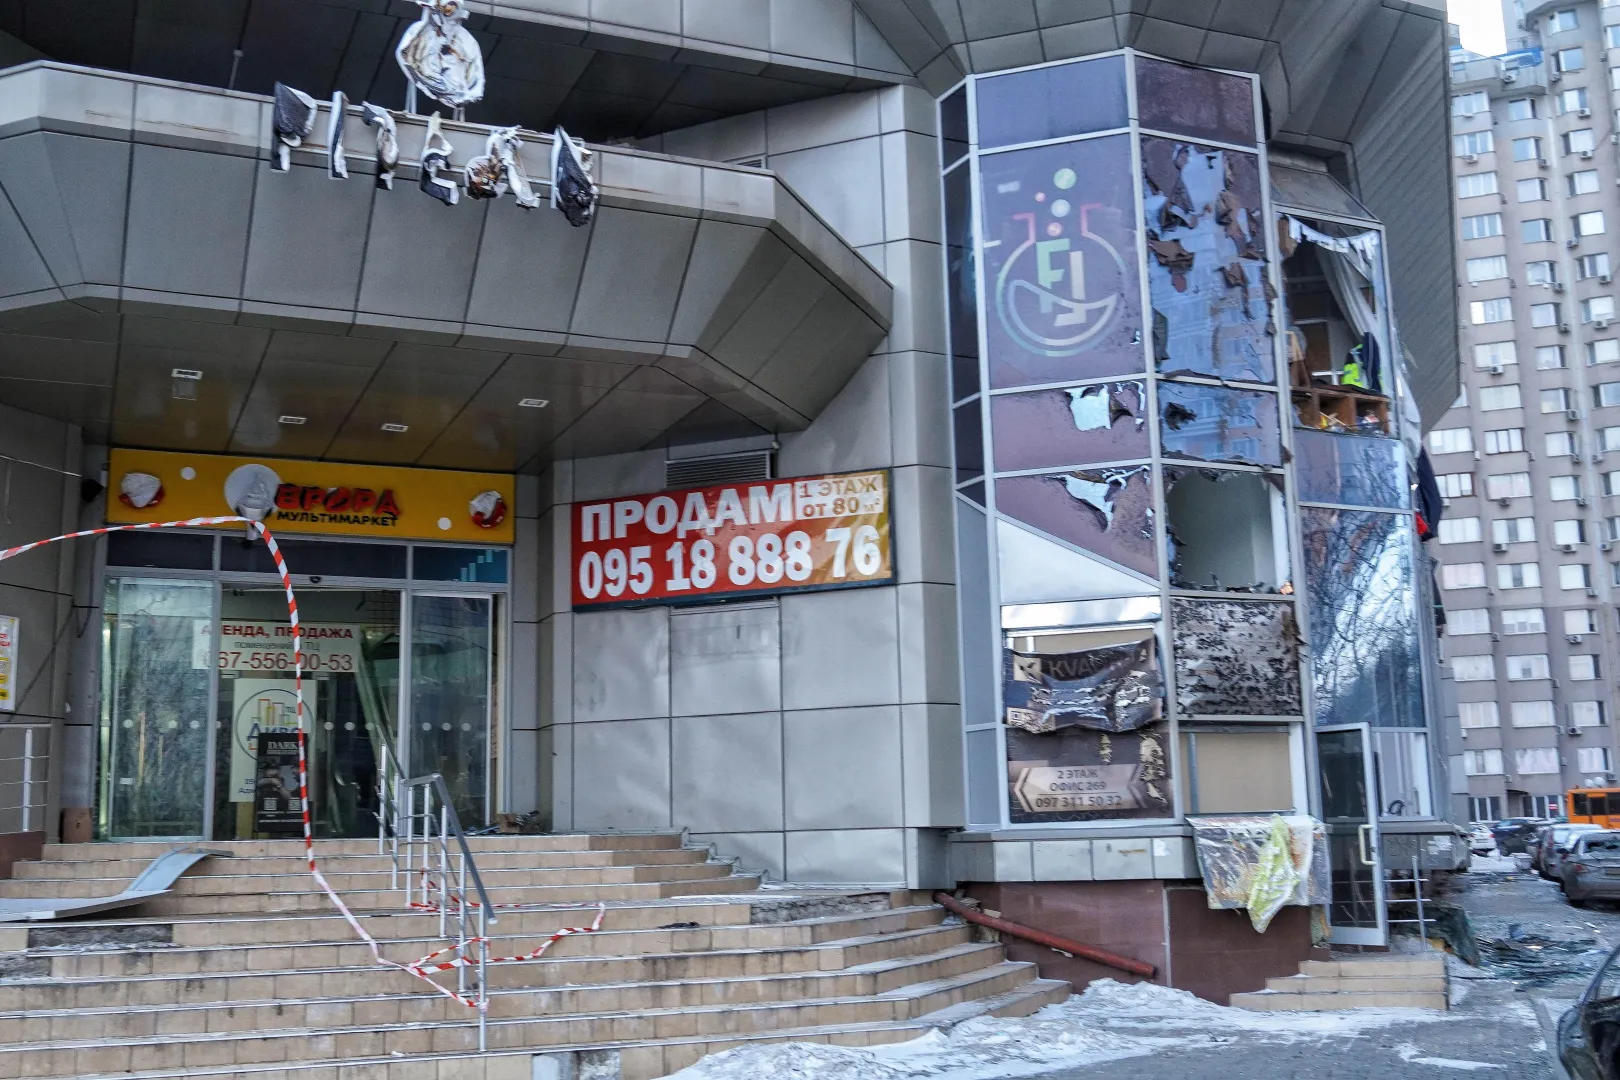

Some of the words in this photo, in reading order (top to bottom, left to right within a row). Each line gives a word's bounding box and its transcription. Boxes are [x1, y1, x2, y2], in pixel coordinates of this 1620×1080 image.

[799, 482, 813, 498] 1
[818, 476, 878, 496] ЭТАЖ
[581, 484, 793, 542] ПРОДАМ
[832, 497, 859, 515] 80
[277, 511, 398, 526] МУЛЬТИМАРКЕТ
[579, 545, 653, 599] 095
[666, 538, 717, 591] 18
[728, 530, 813, 586] 888
[826, 525, 882, 578] 76
[275, 626, 353, 639] ПРОДАЖА
[1057, 770, 1065, 779] 2
[1066, 769, 1098, 779] ЭТАЖ
[1049, 782, 1085, 792] ОФИС
[1086, 781, 1107, 791] 269
[1035, 797, 1058, 808] 097
[1061, 797, 1084, 807] 311
[1088, 796, 1105, 807] 50
[1106, 795, 1122, 806] 32
